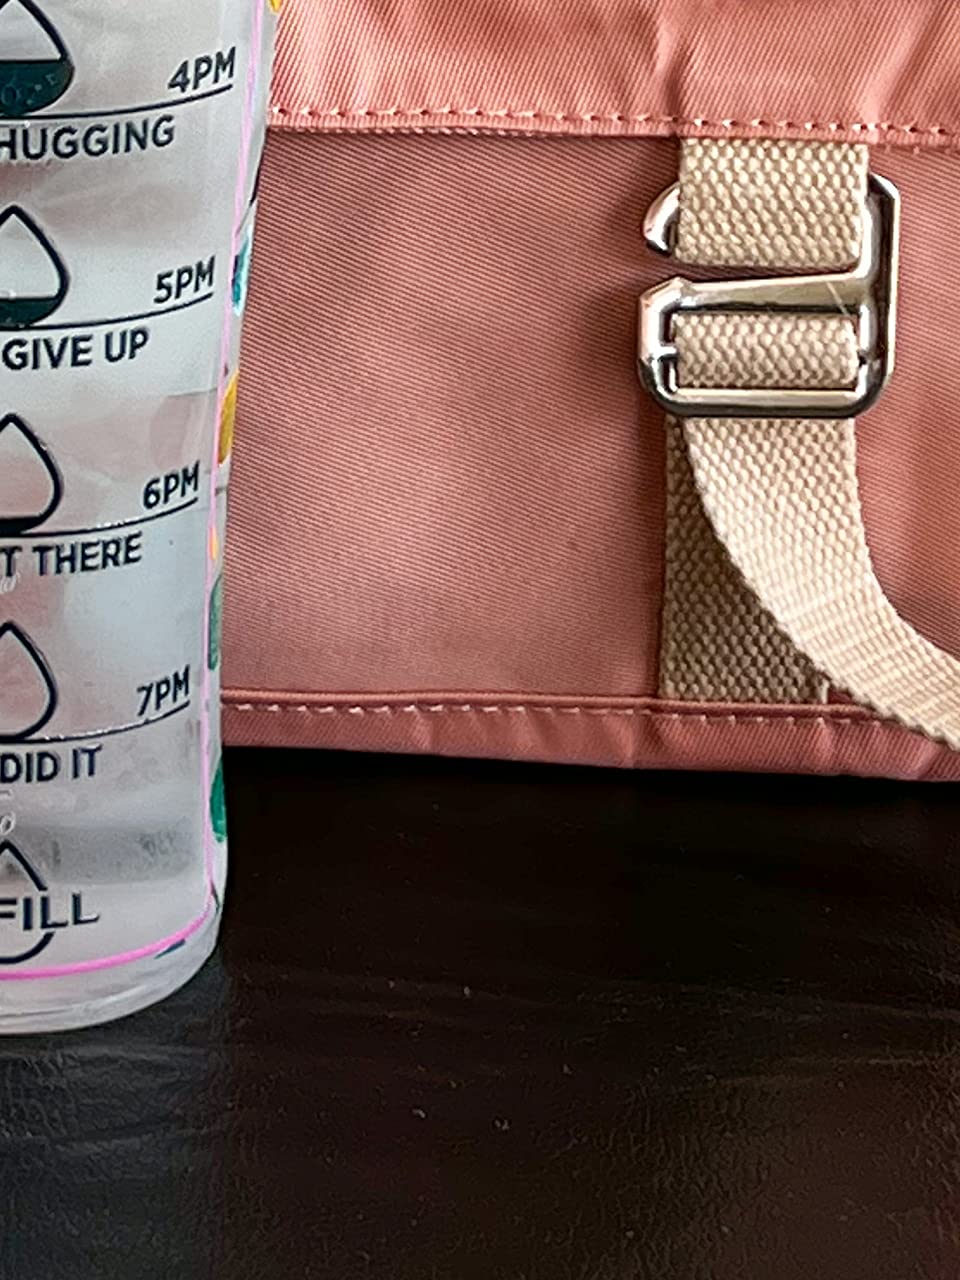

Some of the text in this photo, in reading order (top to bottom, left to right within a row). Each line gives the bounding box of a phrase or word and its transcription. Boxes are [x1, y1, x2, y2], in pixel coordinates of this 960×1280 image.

[168, 48, 236, 94] 4PM
[153, 257, 215, 304] 5PM
[3, 336, 92, 370] GIVE
[105, 328, 149, 362] UP
[143, 462, 200, 508] 6PM
[33, 532, 142, 576] THERE
[137, 666, 190, 716] 7PM
[0, 748, 59, 784] DID
[71, 746, 102, 778] IT
